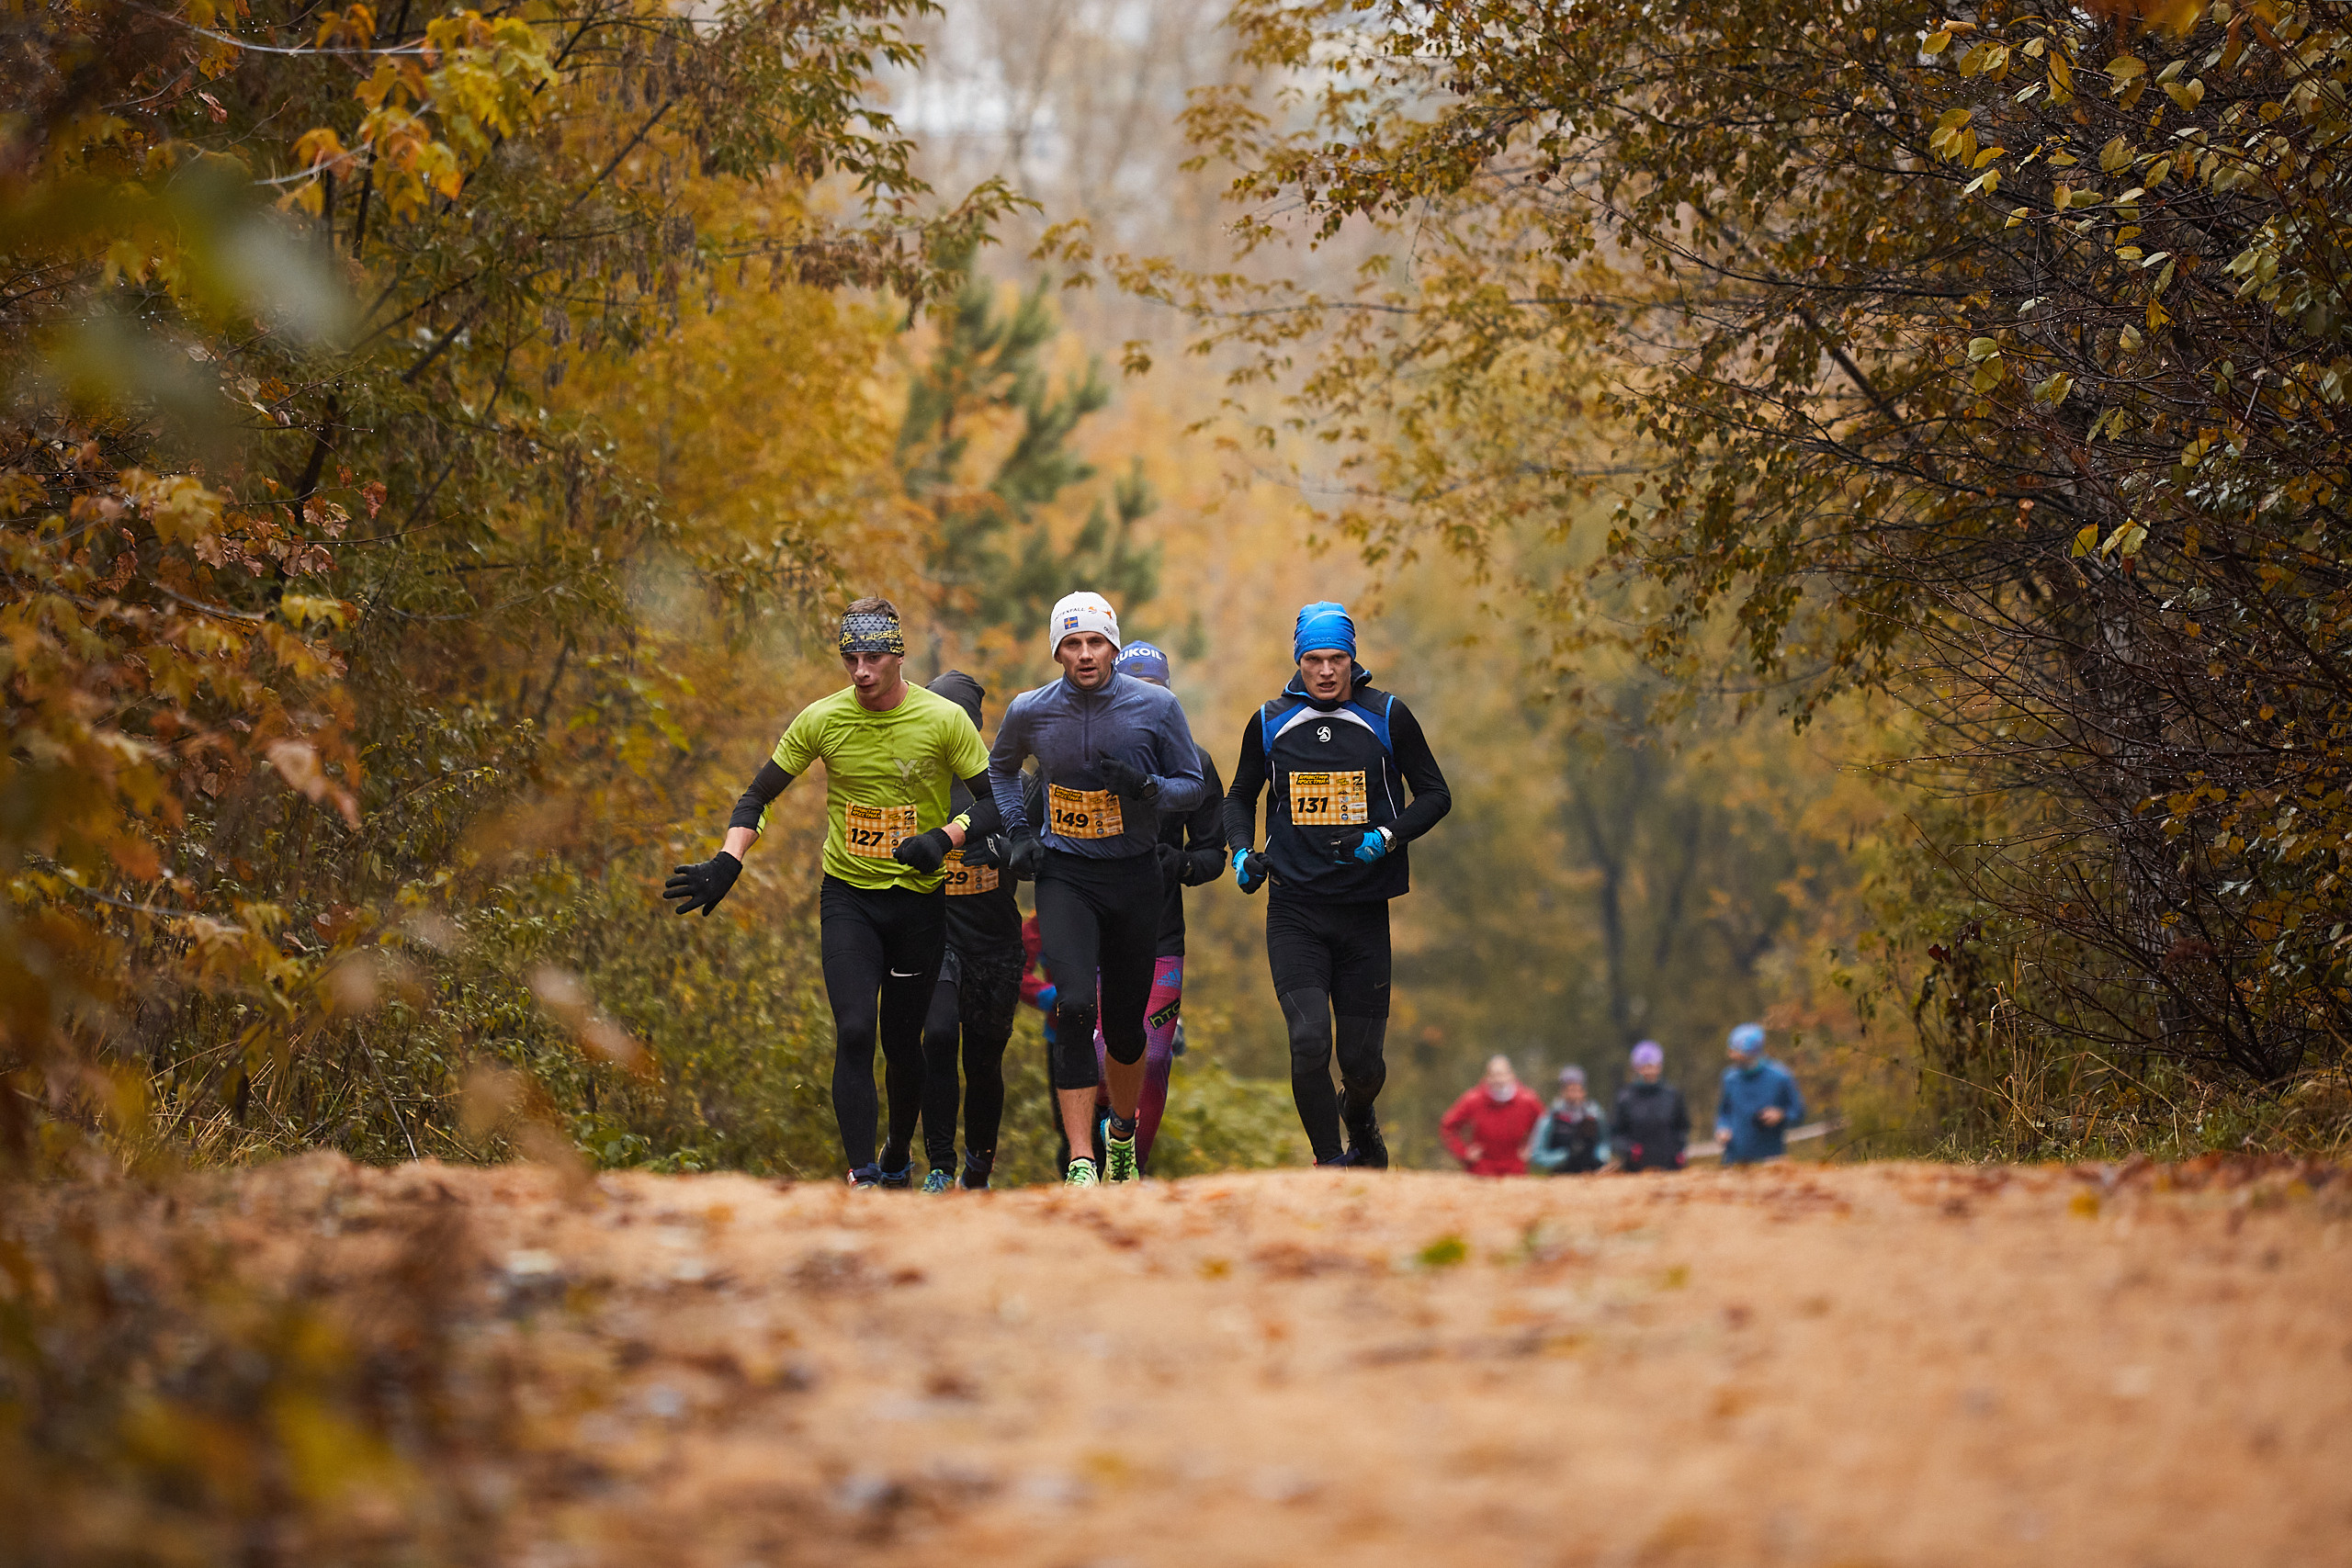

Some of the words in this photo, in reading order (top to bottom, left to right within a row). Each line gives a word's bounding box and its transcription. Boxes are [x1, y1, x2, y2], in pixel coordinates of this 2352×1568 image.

[1114, 648, 1162, 666] LUKOIL
[1297, 797, 1329, 813] 131
[1056, 809, 1088, 828] 149
[852, 829, 884, 846] 127
